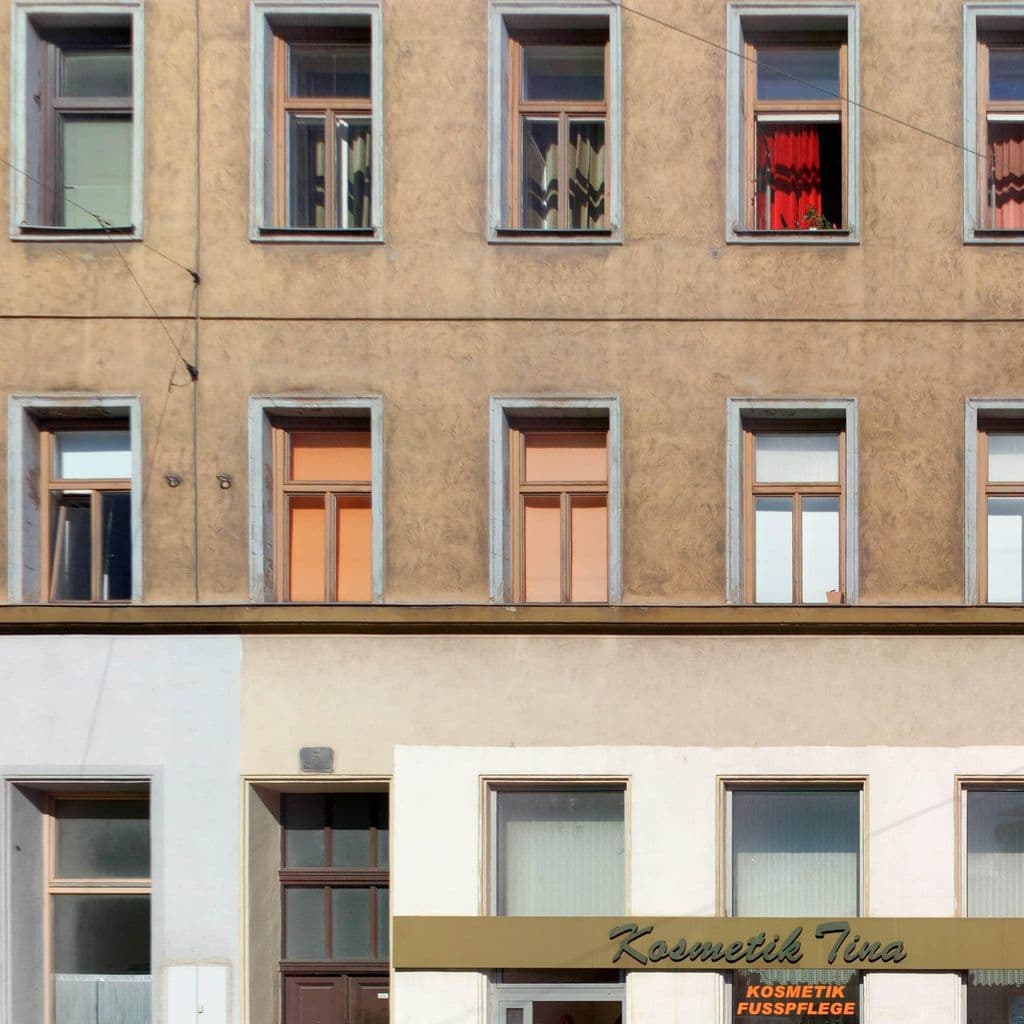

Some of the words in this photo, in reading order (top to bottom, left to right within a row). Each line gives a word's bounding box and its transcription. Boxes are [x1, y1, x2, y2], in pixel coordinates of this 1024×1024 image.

[609, 922, 804, 965] Kosmetik
[815, 921, 908, 965] Tina
[746, 985, 846, 999] KOSMETIK
[736, 1002, 856, 1016] FUSSPFLEGE
